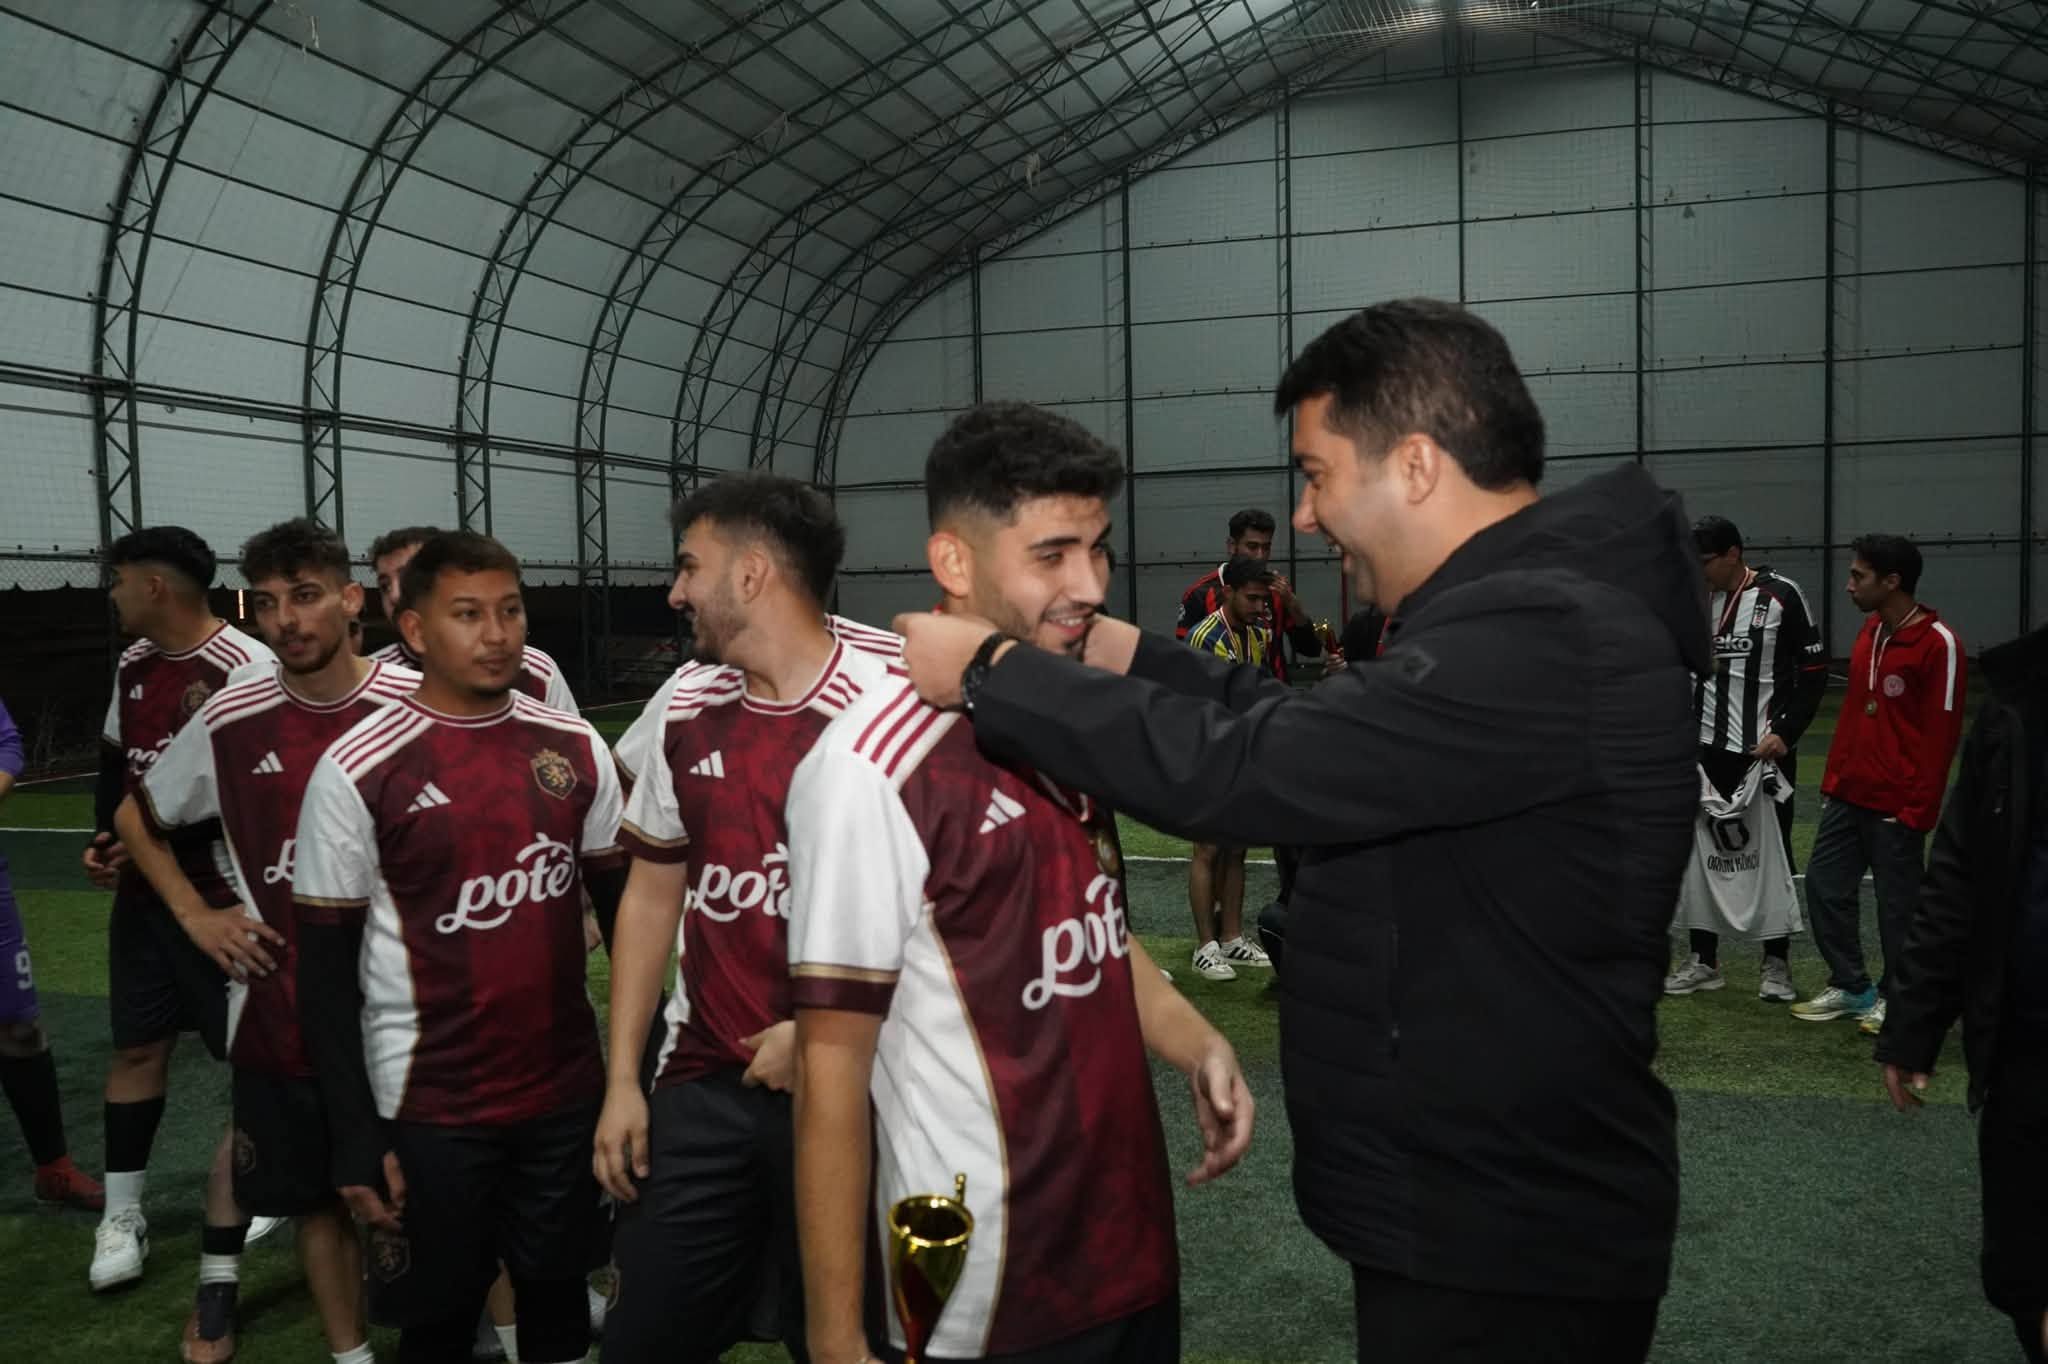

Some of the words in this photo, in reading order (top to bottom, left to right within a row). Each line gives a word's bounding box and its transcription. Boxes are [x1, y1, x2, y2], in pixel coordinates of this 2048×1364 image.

[1712, 633, 1754, 652] eko
[1021, 873, 1129, 1010] pot
[15, 950, 33, 990] 9
